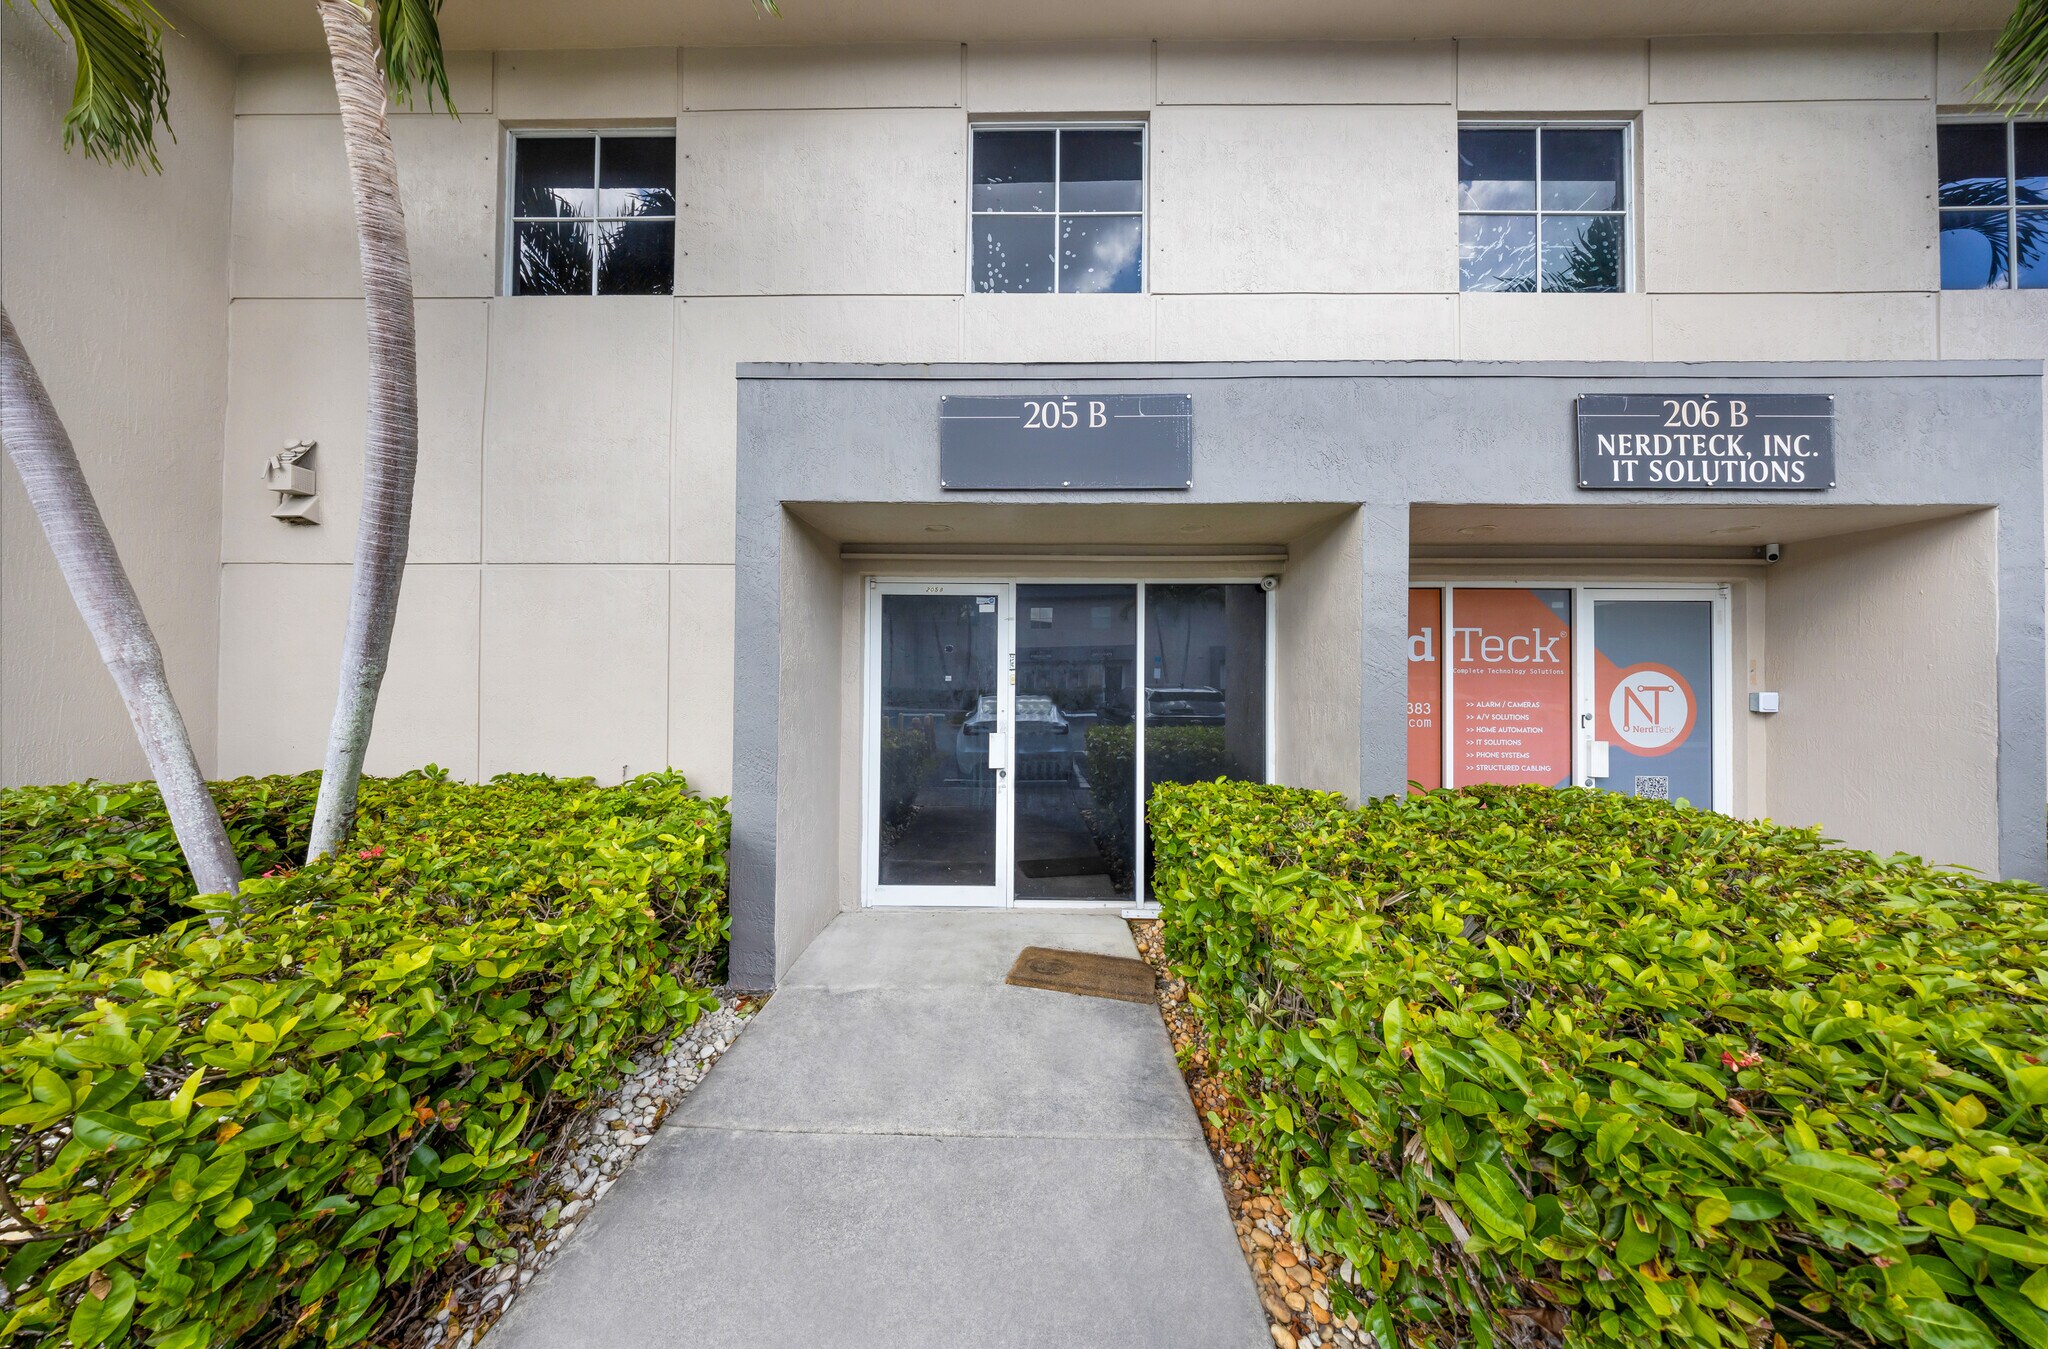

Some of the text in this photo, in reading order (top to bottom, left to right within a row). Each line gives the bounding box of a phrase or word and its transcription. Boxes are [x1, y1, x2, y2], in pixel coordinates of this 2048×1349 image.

[1023, 401, 1107, 429] 205 B
[1663, 400, 1748, 428] 206 B
[1597, 434, 1819, 460] NERDTECK, INC.
[1612, 460, 1805, 483] IT SOLUTIONS
